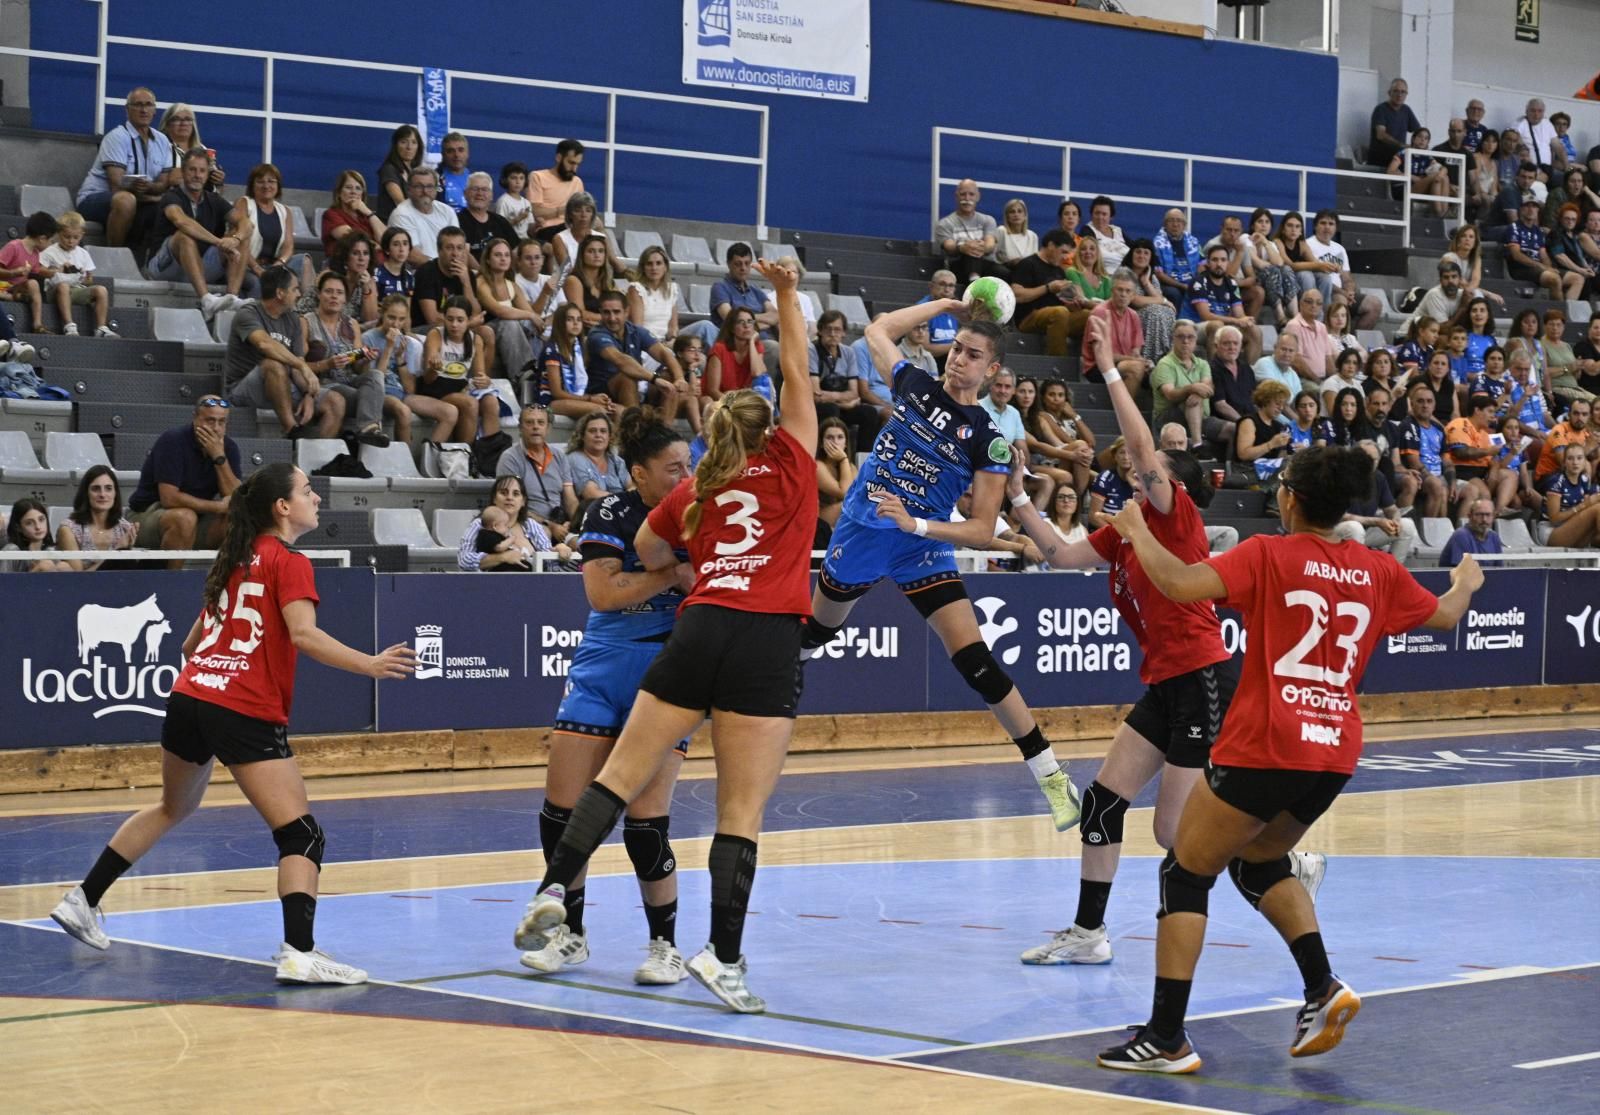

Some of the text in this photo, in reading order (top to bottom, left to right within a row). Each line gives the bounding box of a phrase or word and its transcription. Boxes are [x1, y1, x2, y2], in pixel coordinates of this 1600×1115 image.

[736, 10, 754, 22] SAN
[737, 28, 793, 44] Donostia Kirola
[702, 64, 850, 94] www.donostiakirola.eus
[927, 406, 952, 431] 16
[897, 459, 939, 484] amara
[903, 449, 942, 474] super
[714, 489, 765, 556] 3
[1037, 607, 1121, 643] super
[1468, 606, 1525, 627] Donostia
[1273, 589, 1371, 687] 23
[1466, 630, 1523, 650] Kirola
[446, 657, 487, 666] DONOSTIA
[1036, 643, 1130, 673] amara
[446, 669, 464, 679] SAN
